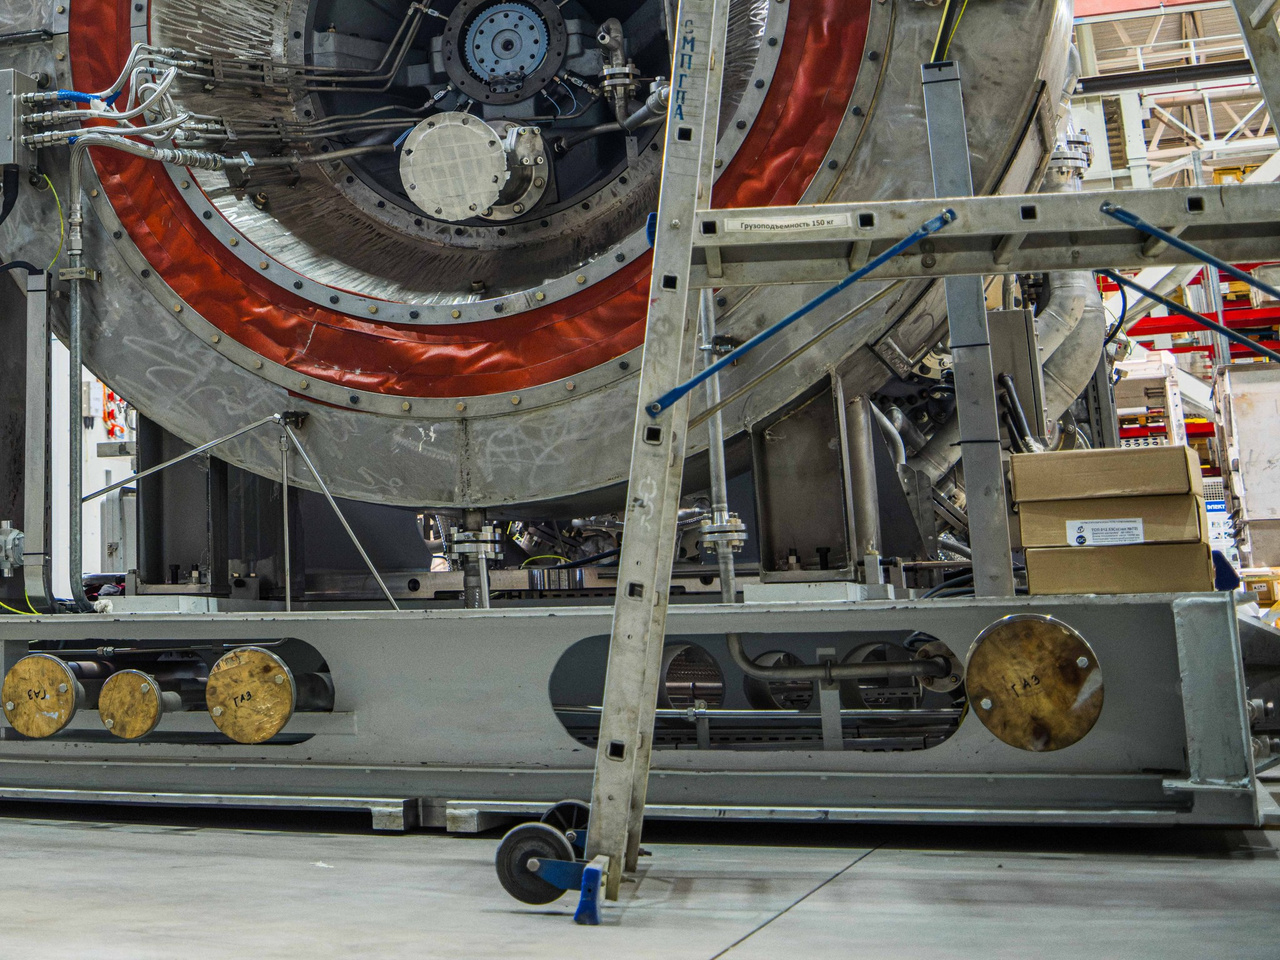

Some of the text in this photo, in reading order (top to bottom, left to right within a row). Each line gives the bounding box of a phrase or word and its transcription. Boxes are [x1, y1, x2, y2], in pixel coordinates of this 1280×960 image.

[27, 689, 47, 700] ГАЗ
[1011, 675, 1040, 698] ГАЗ
[233, 690, 252, 708] ГАЗ
